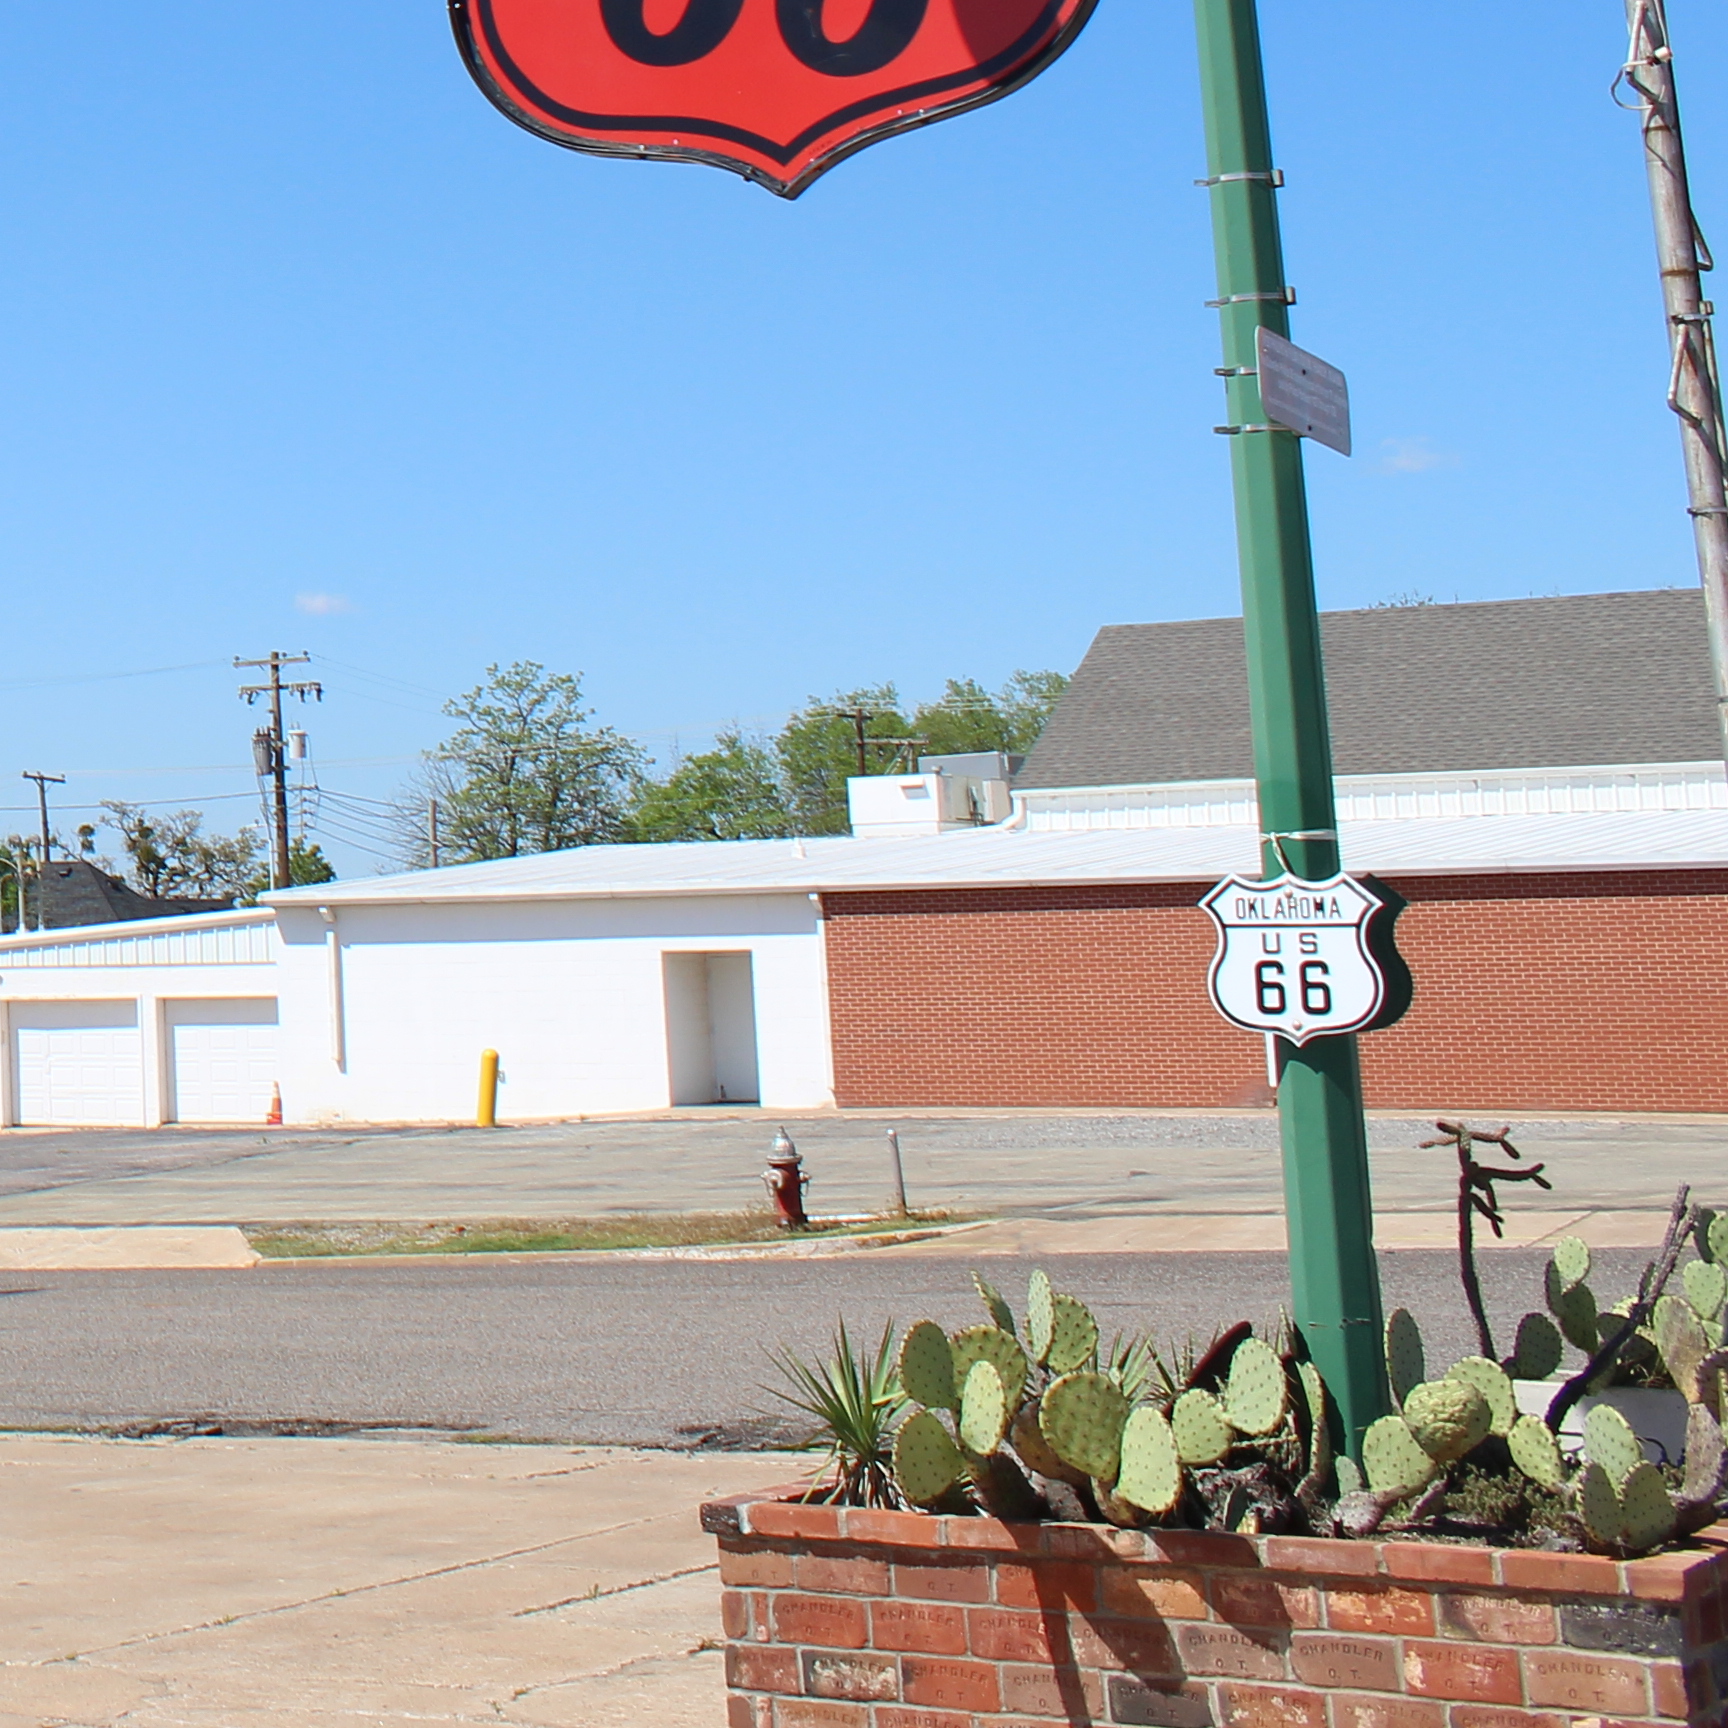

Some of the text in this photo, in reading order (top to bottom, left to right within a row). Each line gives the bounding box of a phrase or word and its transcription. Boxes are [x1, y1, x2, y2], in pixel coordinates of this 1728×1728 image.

[1235, 896, 1342, 919] OKLAHOMA
[1254, 960, 1332, 1015] 66
[1300, 1643, 1384, 1662] CHANDLER
